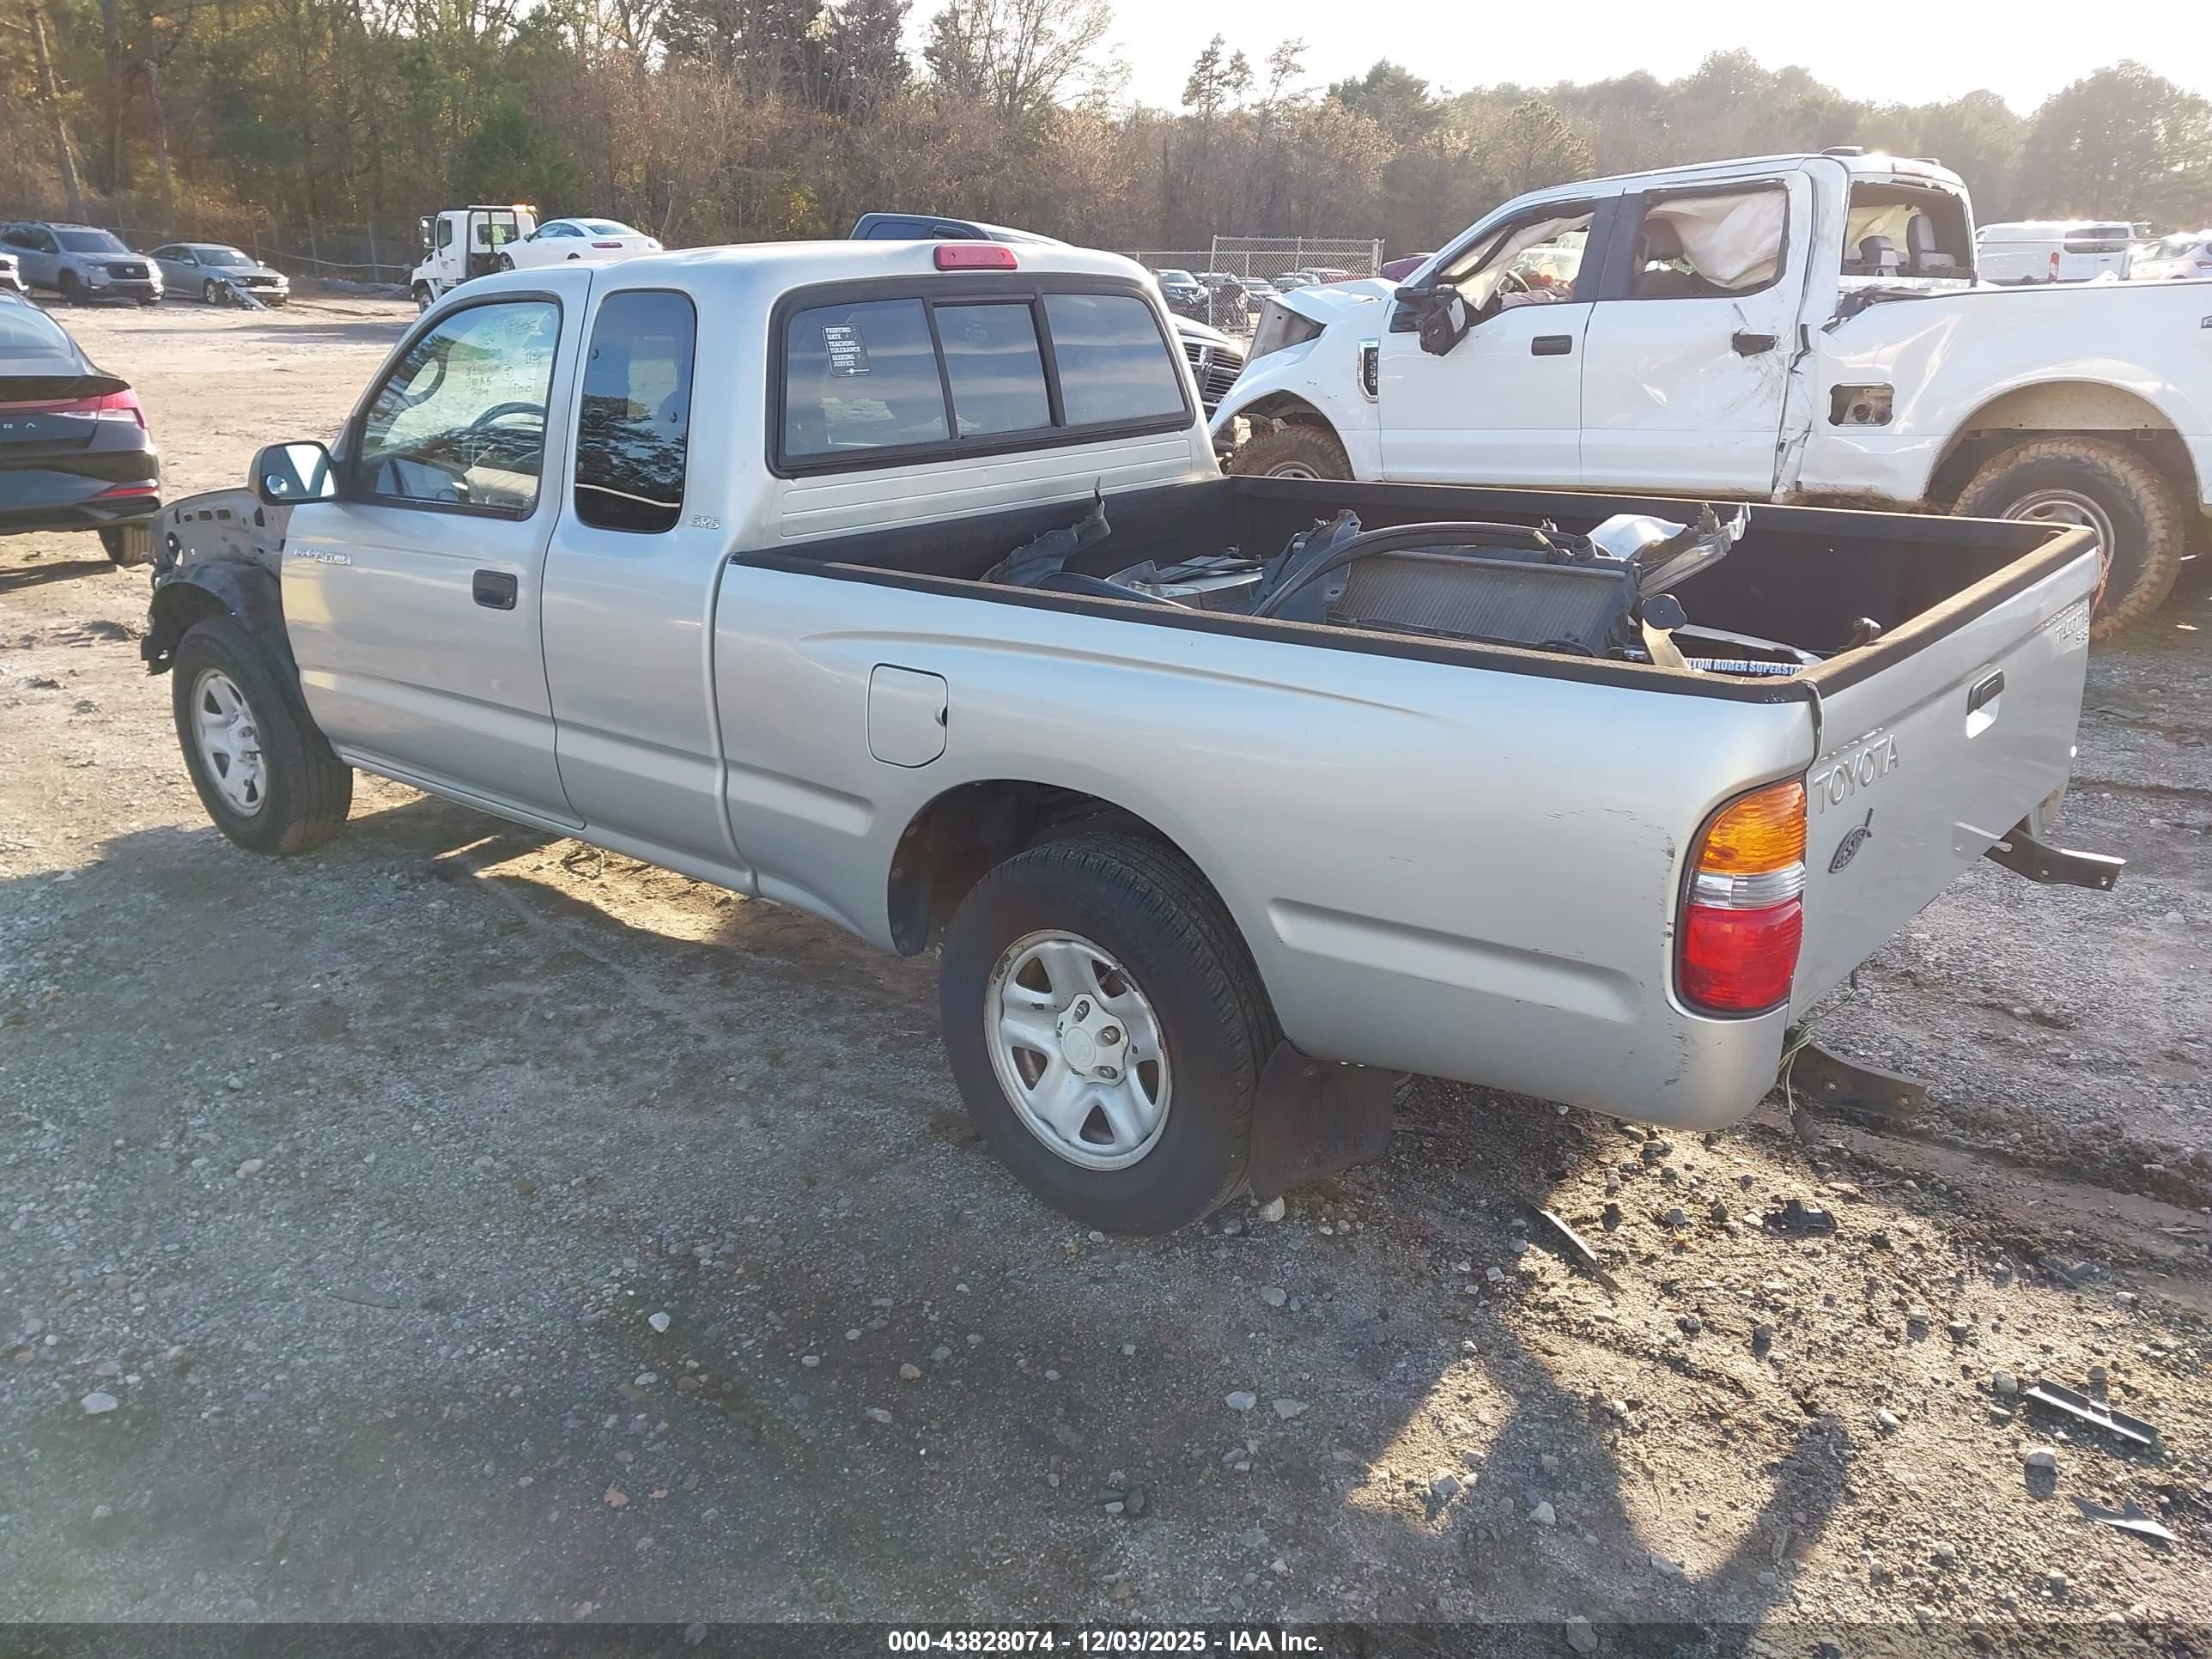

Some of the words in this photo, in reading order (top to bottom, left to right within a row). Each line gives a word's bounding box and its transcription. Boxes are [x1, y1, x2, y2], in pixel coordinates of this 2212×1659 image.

[691, 515, 720, 529] SR5
[1713, 660, 1747, 672] RUBEN
[1814, 734, 1899, 815] TOYOTA
